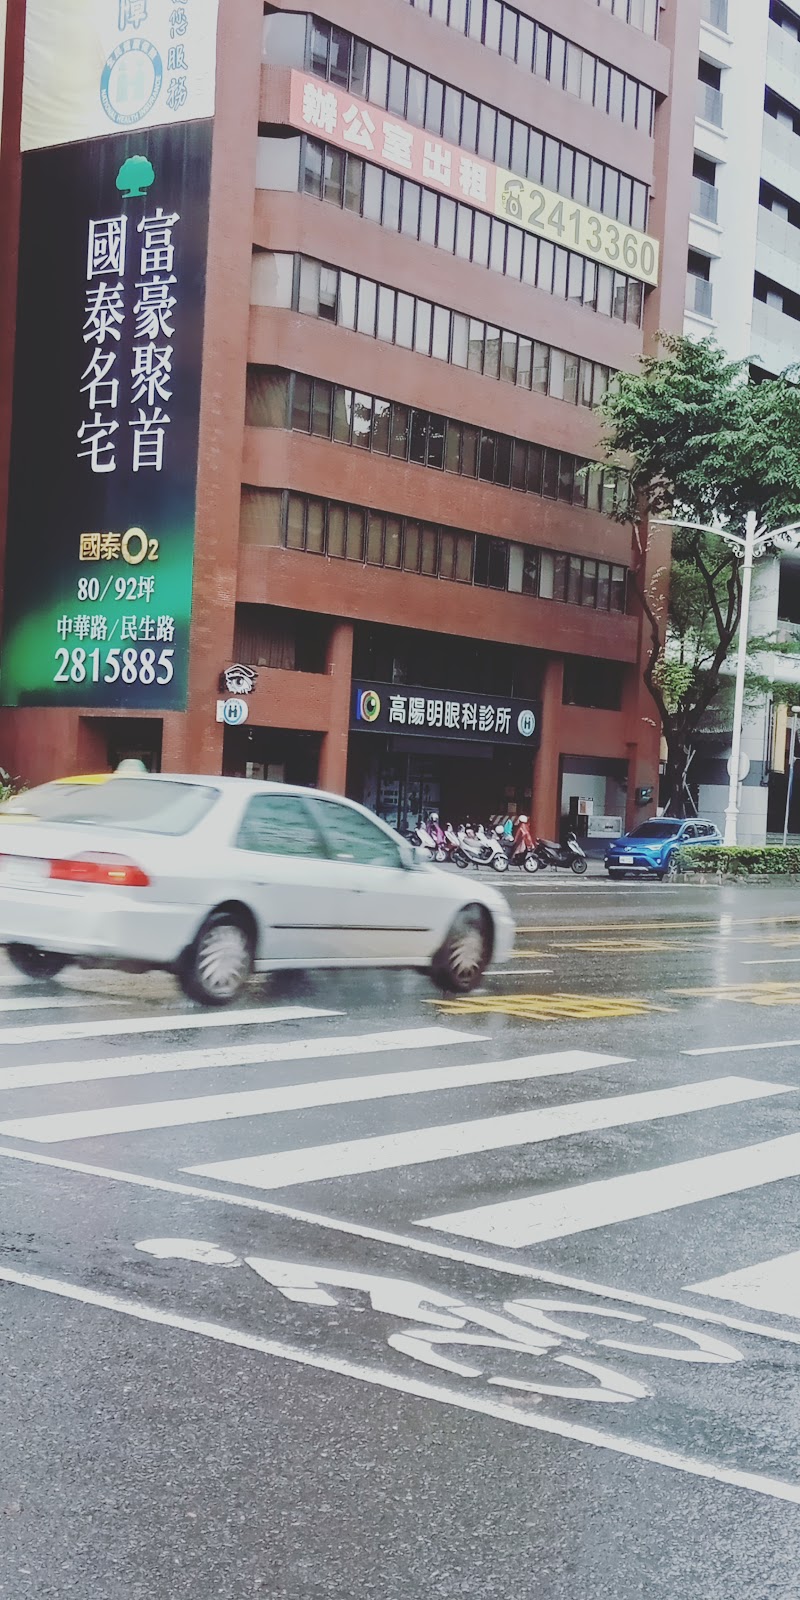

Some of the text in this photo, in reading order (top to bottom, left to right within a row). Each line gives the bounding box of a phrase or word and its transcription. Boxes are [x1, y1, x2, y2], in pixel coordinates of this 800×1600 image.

[166, 0, 189, 111] 您服務
[116, 112, 139, 123] HEALTH
[302, 82, 488, 203] 辦公室出租
[527, 188, 656, 277] 2413360
[76, 214, 128, 473] 國泰名宅
[129, 207, 181, 472] 富豪聚首
[53, 647, 175, 686] 2815885
[388, 694, 512, 735] 高陽明眼科診所
